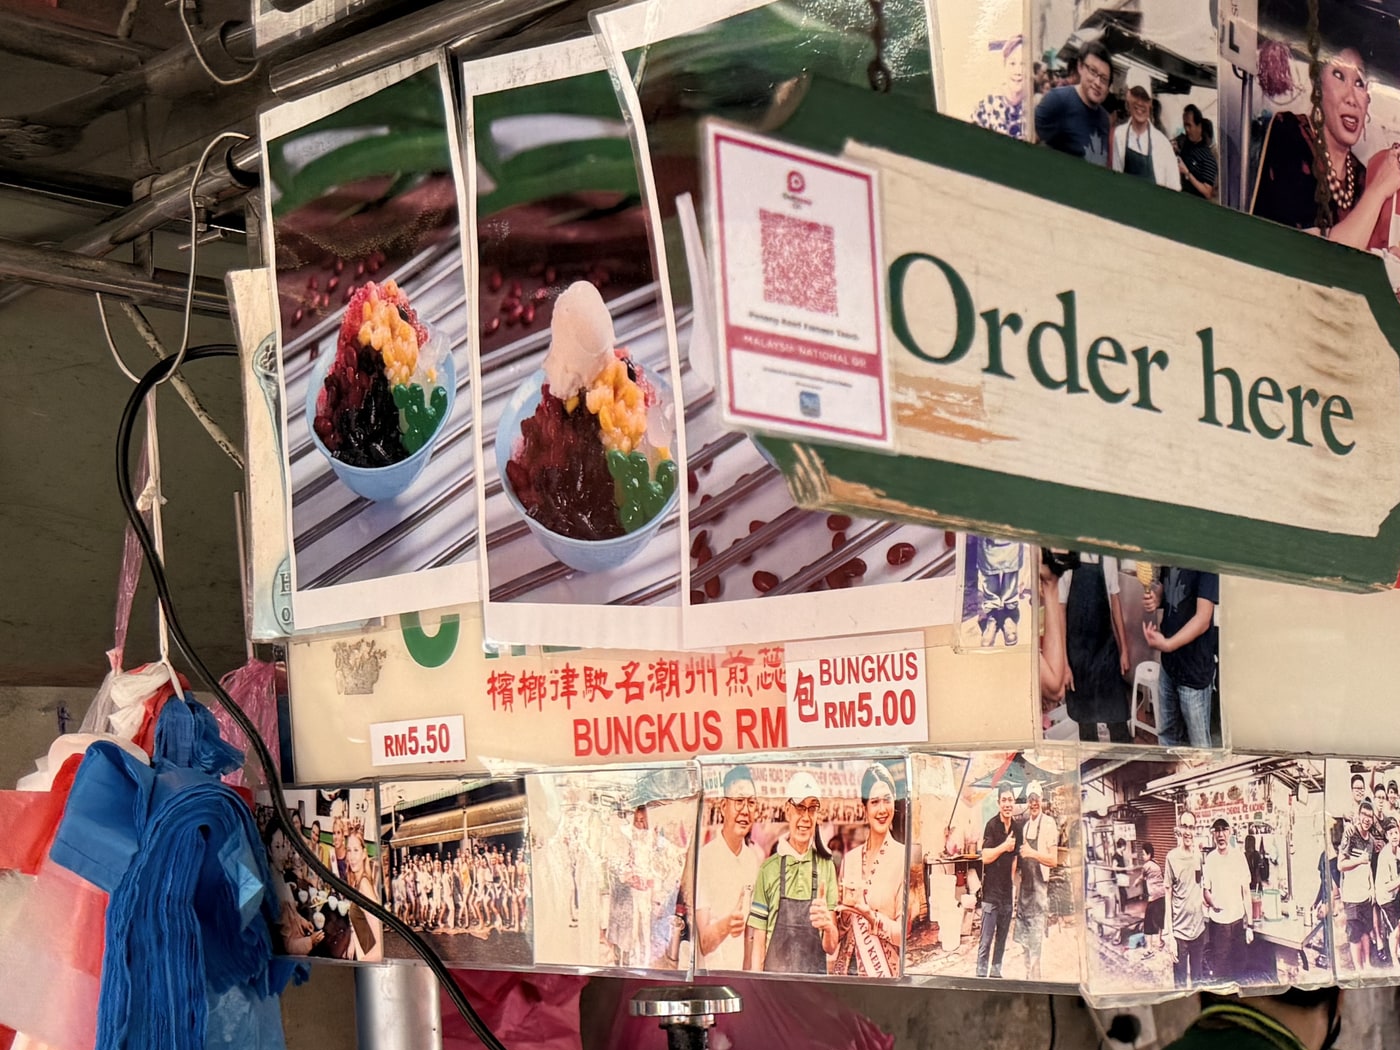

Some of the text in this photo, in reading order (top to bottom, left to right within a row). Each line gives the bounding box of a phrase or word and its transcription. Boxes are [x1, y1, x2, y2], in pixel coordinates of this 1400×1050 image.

[743, 335, 795, 353] MALAYSIA
[799, 346, 849, 365] NATIONAL
[889, 252, 1355, 456] Order here
[819, 651, 919, 686] BUNGKUS
[793, 668, 819, 723] 包
[824, 689, 917, 729] RM5.00
[384, 723, 450, 757] RM5.50
[573, 706, 787, 757] BUNGKUS RM
[867, 945, 886, 978] KEBA
